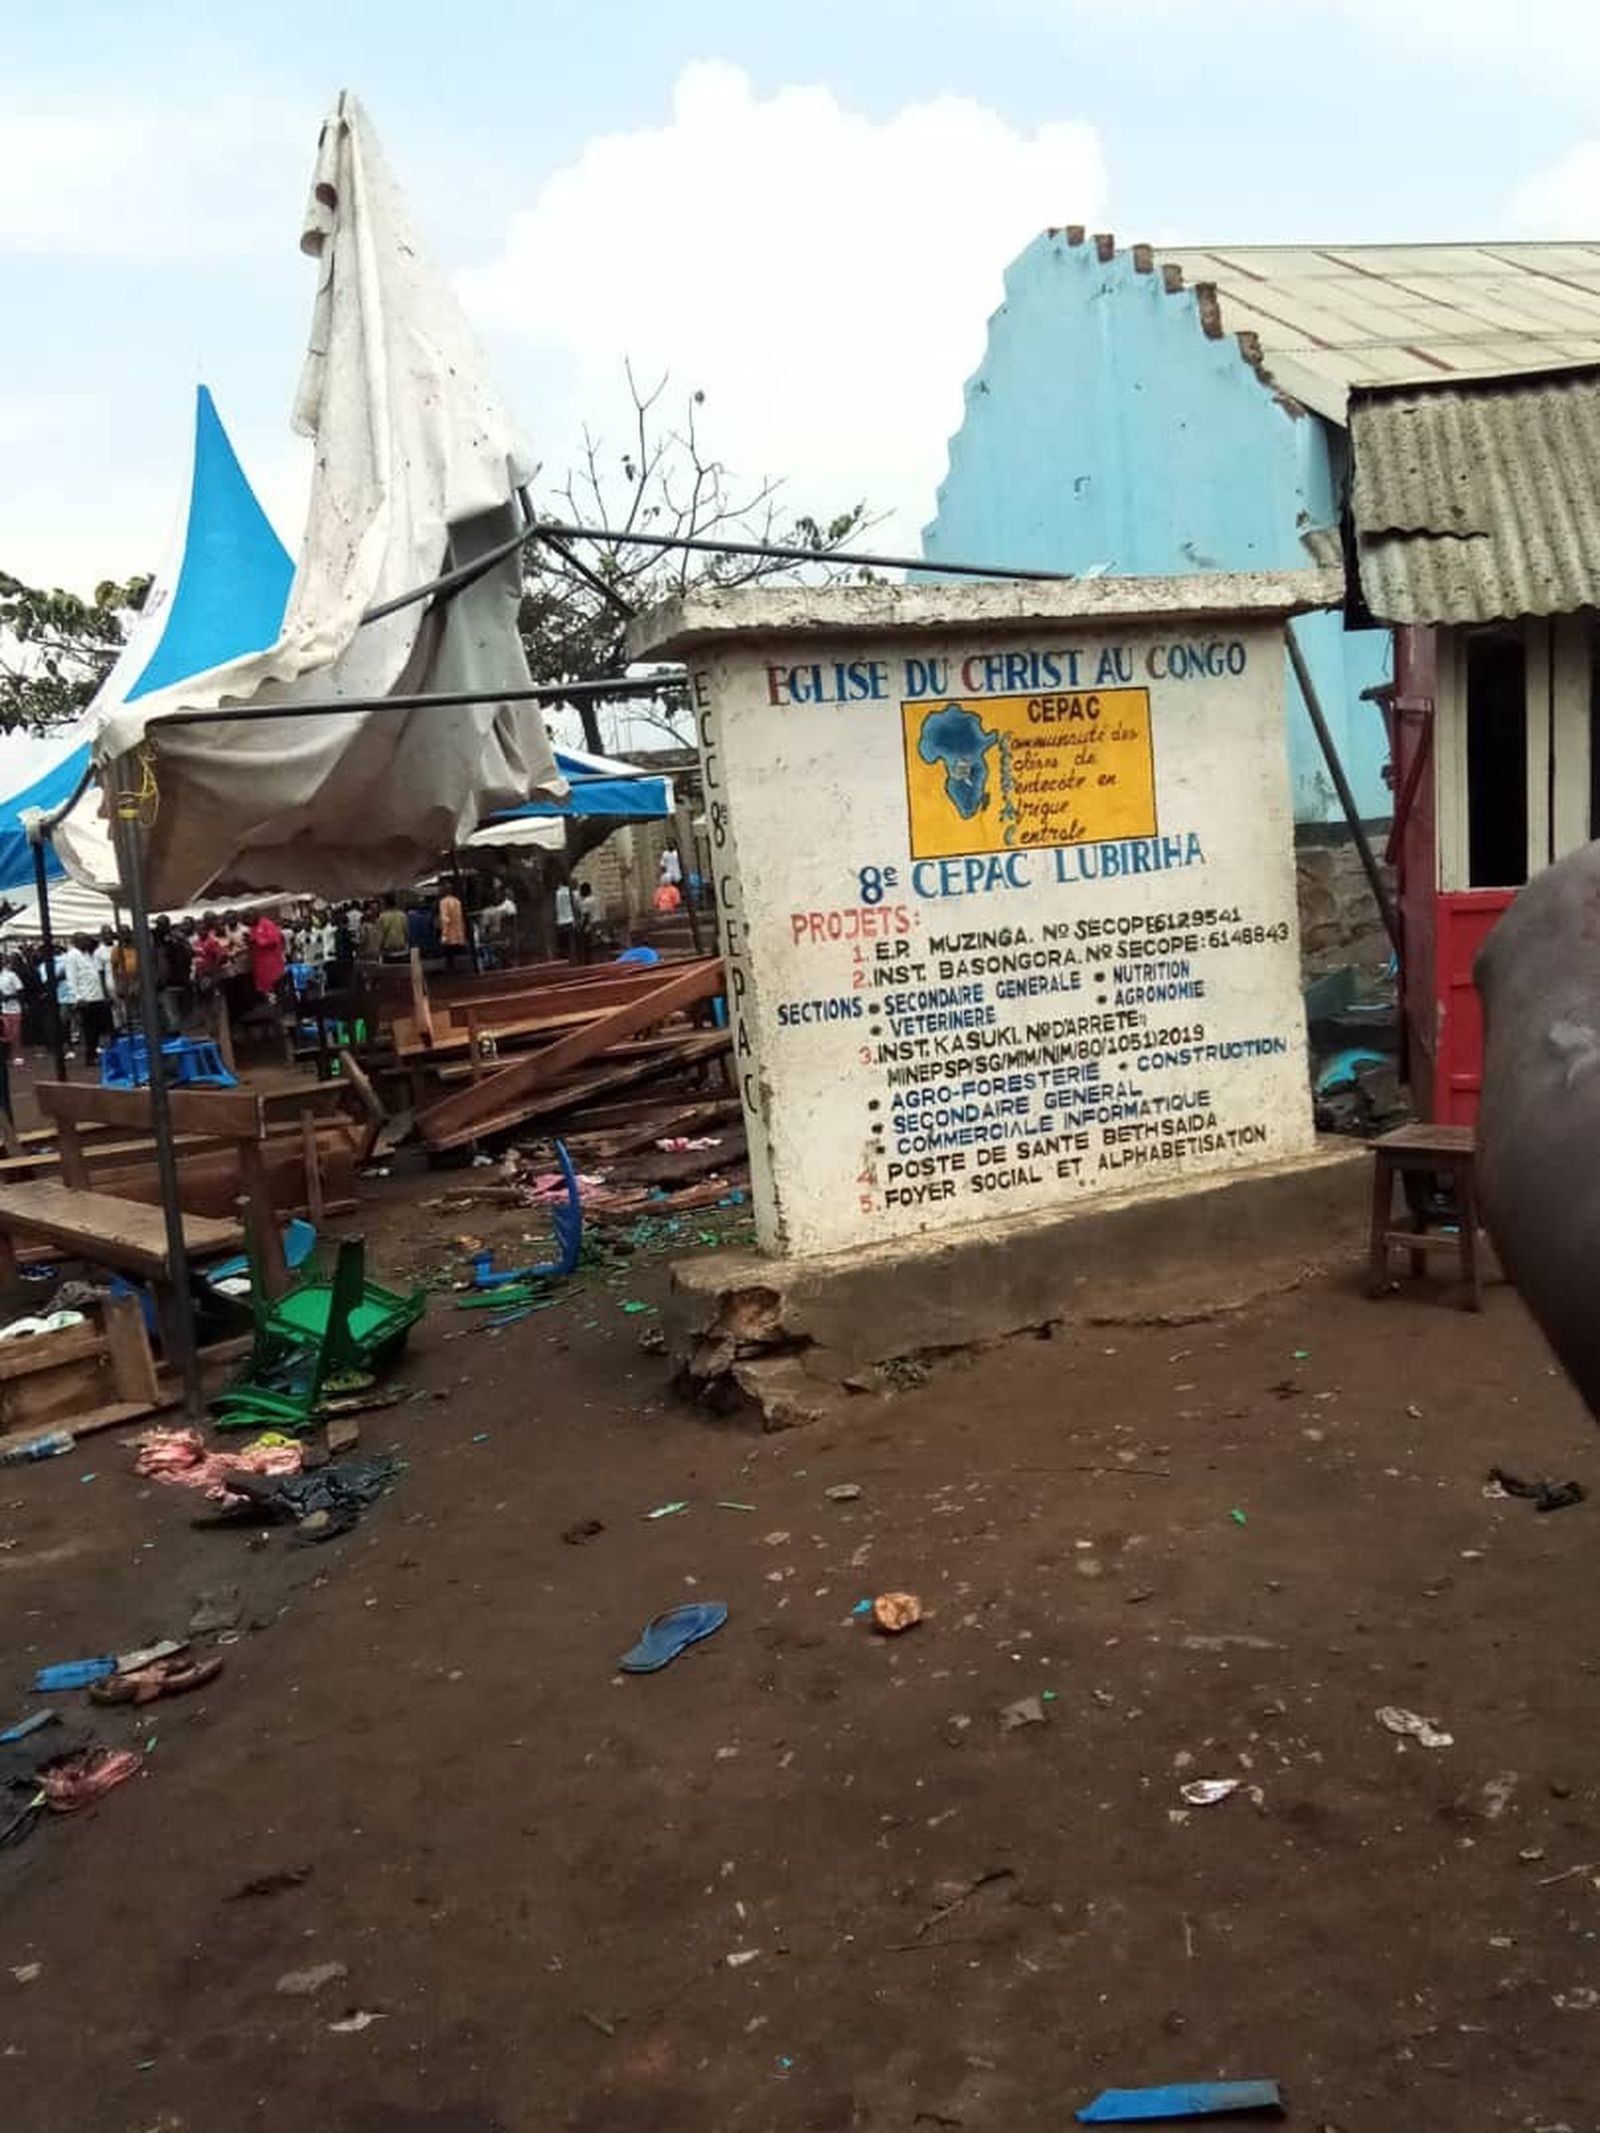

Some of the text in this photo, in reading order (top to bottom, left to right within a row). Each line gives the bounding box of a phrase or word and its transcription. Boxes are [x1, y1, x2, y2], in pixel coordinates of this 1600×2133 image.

[767, 642, 1247, 706] EGLISE DU CHRIST AU CONGO
[1027, 695, 1101, 724] CEPAC
[1074, 750, 1096, 767] de
[1097, 773, 1116, 786] en
[1003, 818, 1086, 847] Centrale
[911, 852, 1032, 899] CEPAC
[1055, 832, 1206, 884] LUBIRIHA
[790, 904, 921, 946] PROJETS:
[777, 959, 1190, 1027] SECTIONS SECONDAIRE GENERALE NUTRITION
[889, 980, 1206, 1039] VETERINERE AGRONOMIE
[891, 1037, 1287, 1111] AGRO-FORESTERIE CONSTRUCTION
[893, 1080, 1143, 1135] SECONDAIRE GENERAL
[897, 1090, 1211, 1156] COMMERCIALE INFORMATIQUE
[885, 1180, 956, 1210] FOYER
[971, 1165, 1043, 1194] SOCIAL
[1056, 1158, 1082, 1179] ET
[1098, 1124, 1267, 1171] ALPHABETISATION
[887, 1152, 966, 1184] POSTE
[976, 1146, 1007, 1167] DE
[1016, 1132, 1090, 1159] SANTE
